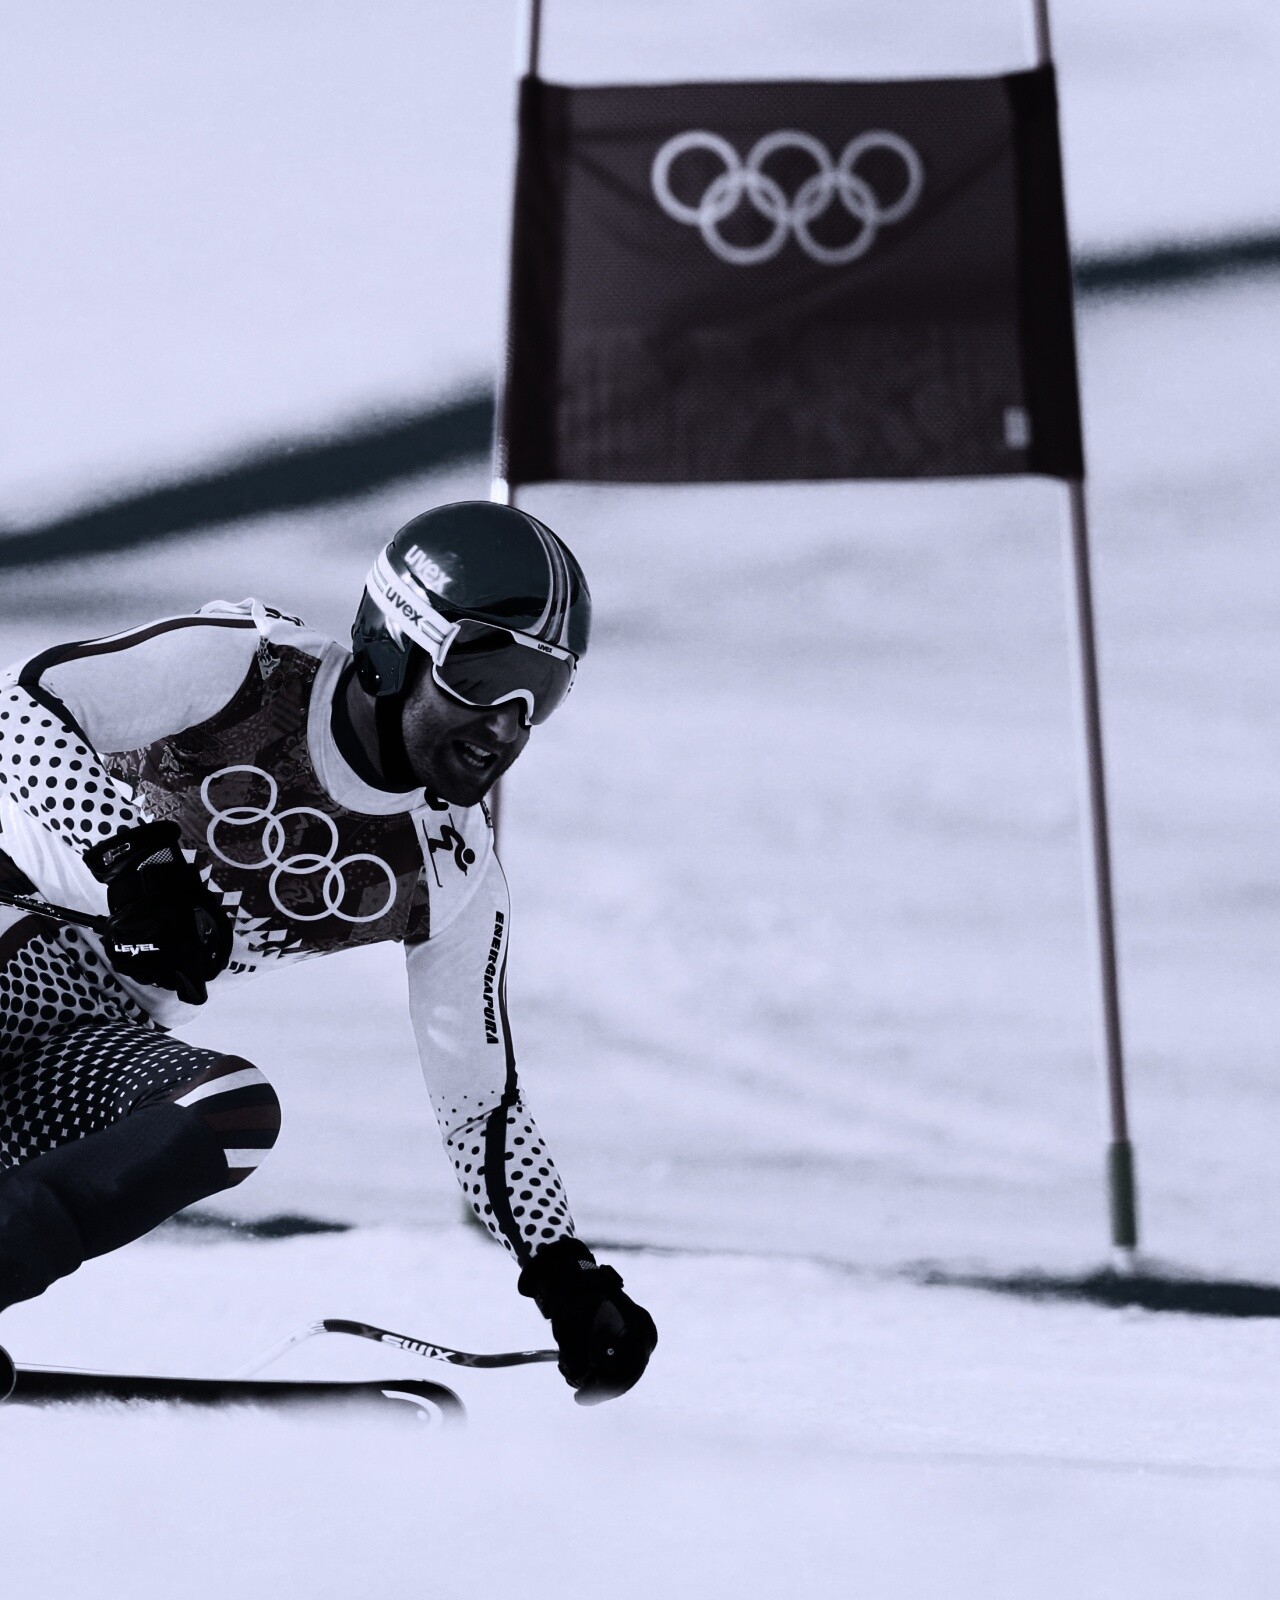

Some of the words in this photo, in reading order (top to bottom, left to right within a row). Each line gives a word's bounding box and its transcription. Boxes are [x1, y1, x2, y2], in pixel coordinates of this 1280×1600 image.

[405, 544, 452, 594] uvex
[385, 586, 423, 626] uvex
[537, 643, 553, 653] uvex
[114, 943, 160, 957] LEVEL
[483, 910, 505, 1044] ENERGIAPURA
[381, 1333, 456, 1363] SWIX
